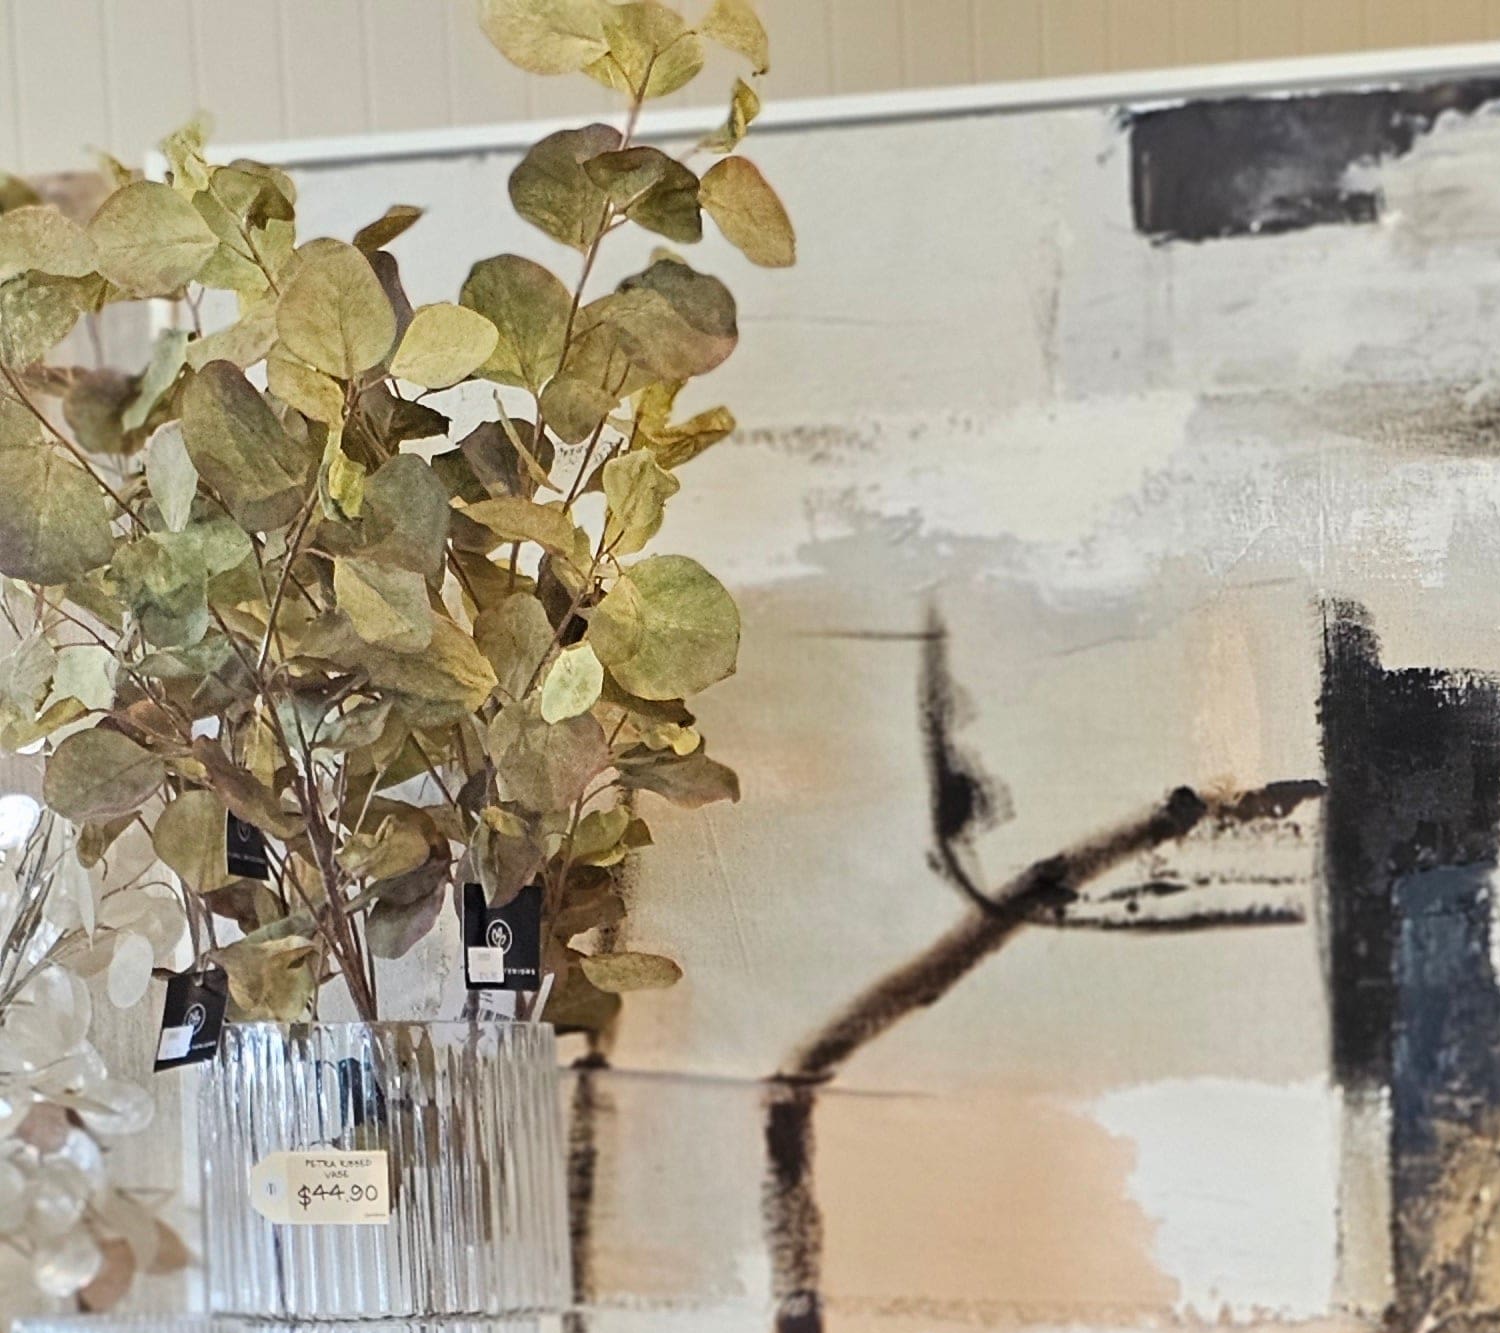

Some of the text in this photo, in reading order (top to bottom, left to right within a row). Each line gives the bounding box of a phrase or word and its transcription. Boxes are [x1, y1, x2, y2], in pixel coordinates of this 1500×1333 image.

[305, 1158, 337, 1168] PETRA
[324, 1170, 350, 1179] VASE
[297, 1183, 379, 1211] $44.90
